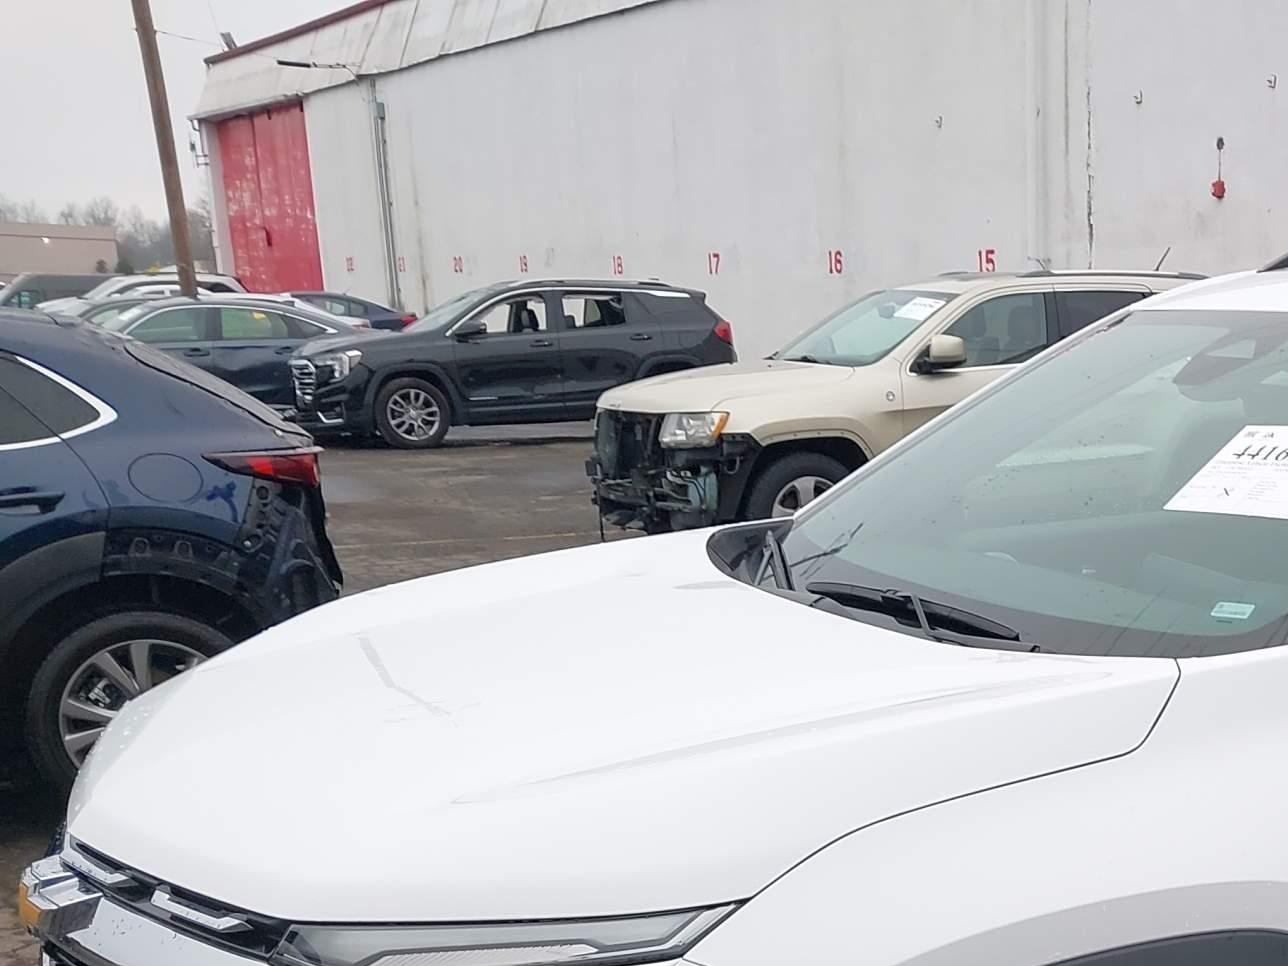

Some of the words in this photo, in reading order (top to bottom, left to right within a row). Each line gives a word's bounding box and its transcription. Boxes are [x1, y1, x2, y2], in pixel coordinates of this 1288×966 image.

[453, 256, 464, 273] 20
[519, 255, 529, 273] 19
[612, 255, 624, 275] 18
[707, 252, 721, 275] 17
[827, 250, 843, 273] 16
[977, 249, 997, 272] 15
